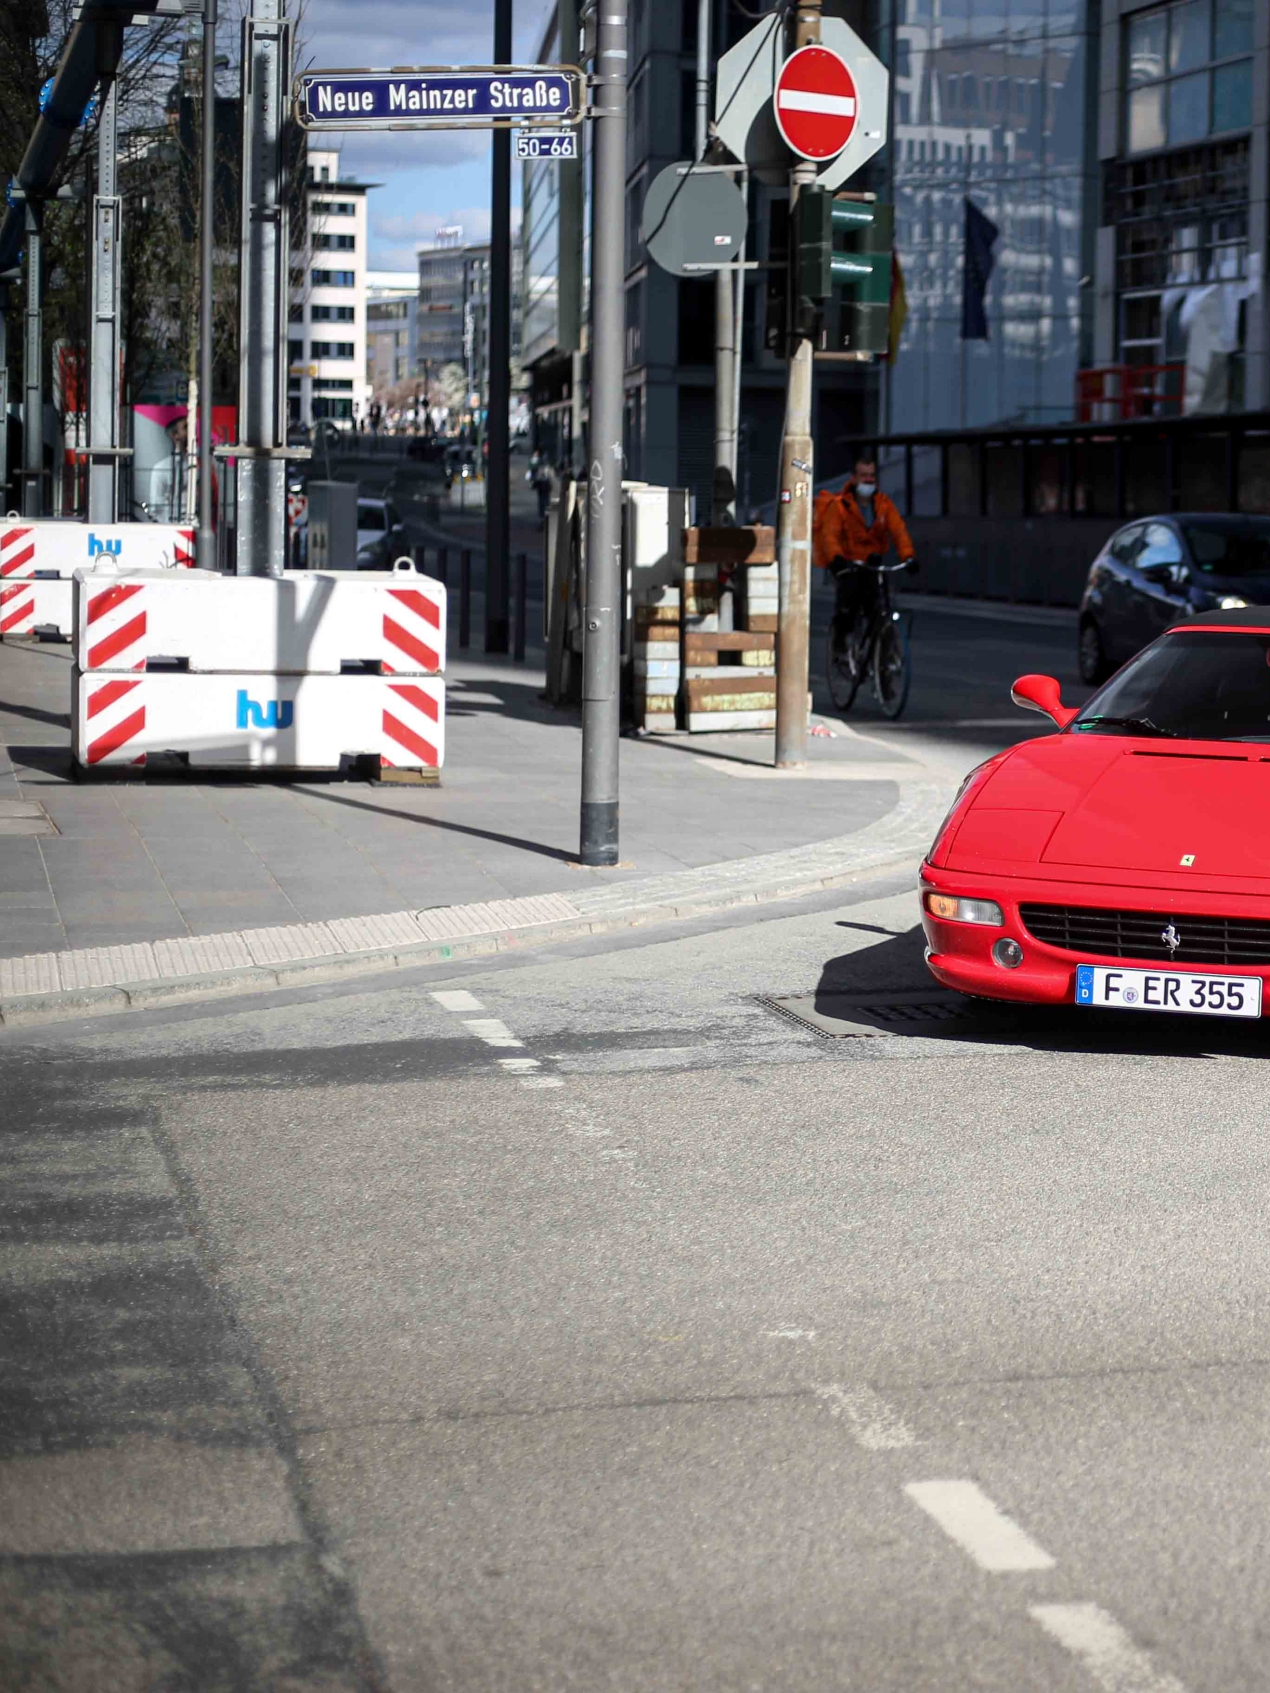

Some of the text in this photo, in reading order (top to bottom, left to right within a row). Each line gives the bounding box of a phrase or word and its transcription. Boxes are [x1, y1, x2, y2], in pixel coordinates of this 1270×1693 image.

[318, 80, 561, 112] Neue Mainzer Straße
[518, 138, 572, 156] 50-66
[1081, 973, 1245, 1011] D F ER 355
